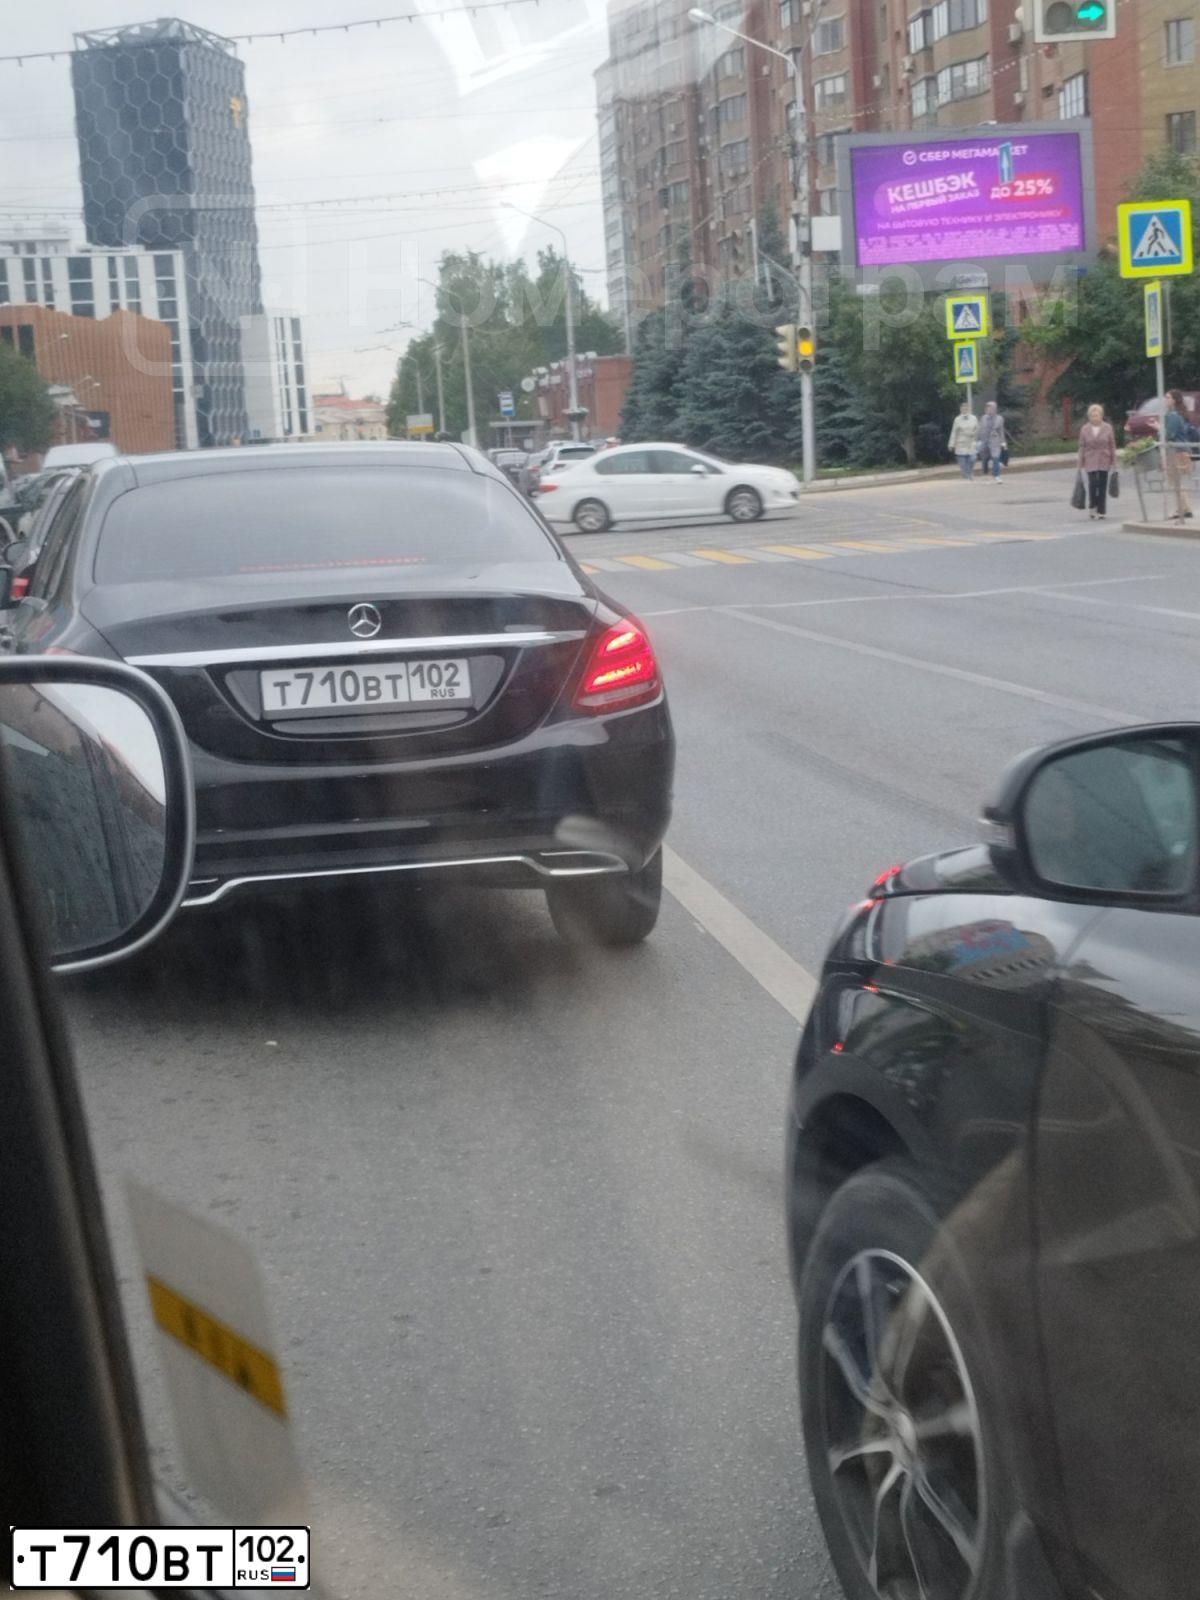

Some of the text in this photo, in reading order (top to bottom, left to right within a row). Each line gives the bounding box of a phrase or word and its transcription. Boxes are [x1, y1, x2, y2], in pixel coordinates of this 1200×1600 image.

[919, 144, 1029, 163] СБЕР МЕГАМАЕТ
[887, 171, 977, 204] КЕШБЭК
[1013, 178, 1053, 197] 25%
[410, 662, 460, 689] 102
[430, 688, 455, 698] RUS
